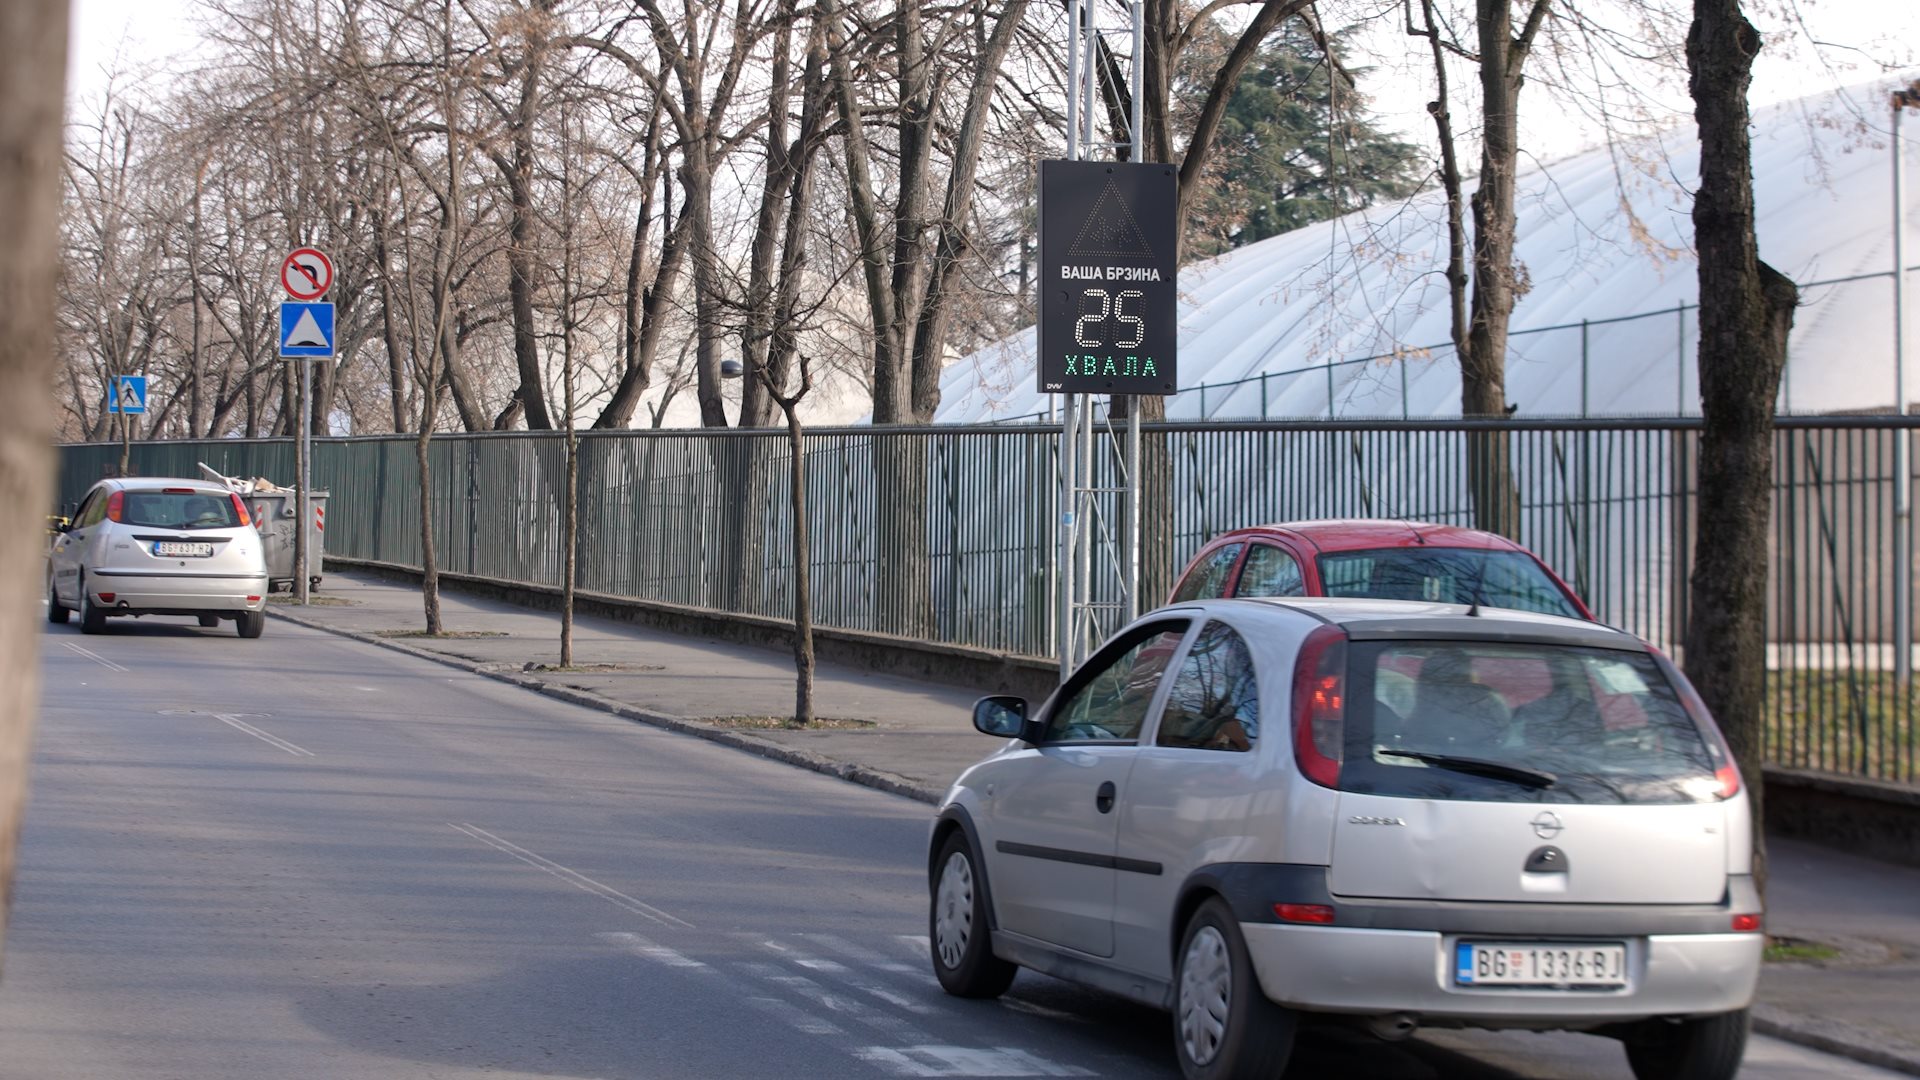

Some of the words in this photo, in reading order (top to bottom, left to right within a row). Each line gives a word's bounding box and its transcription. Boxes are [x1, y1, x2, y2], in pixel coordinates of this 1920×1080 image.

[1061, 265, 1103, 280] ВАША
[1106, 266, 1161, 281] БРЗИНА
[1075, 288, 1145, 349] 25
[1065, 354, 1157, 377] ХВАЛА
[1477, 949, 1507, 978] BG
[1529, 950, 1622, 978] 1336-BJ
